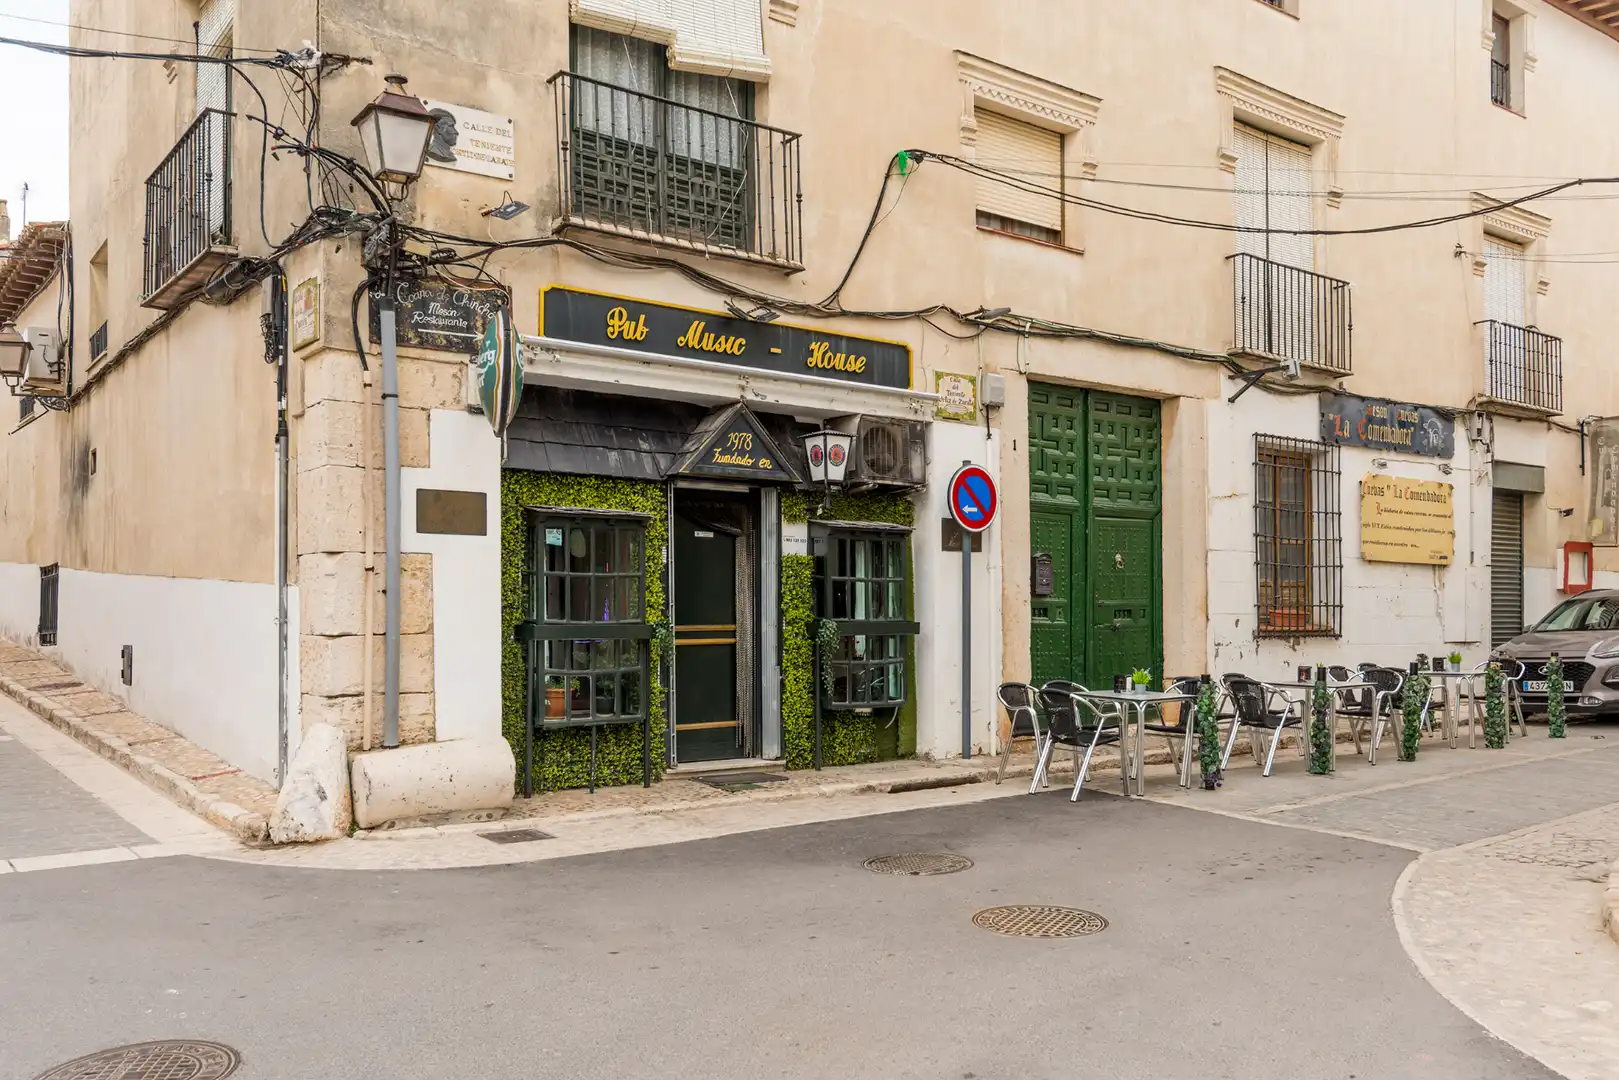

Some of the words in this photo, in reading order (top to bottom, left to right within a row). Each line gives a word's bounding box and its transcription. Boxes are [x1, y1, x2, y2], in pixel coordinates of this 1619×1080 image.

[462, 121, 493, 134] CALLE
[495, 127, 513, 139] DEL
[469, 138, 512, 155] TENIENTE
[411, 310, 468, 329] Restaurante
[606, 306, 649, 342] Pub
[676, 319, 747, 357] Music
[807, 340, 867, 374] House
[726, 432, 753, 451] 1978
[711, 447, 755, 467] Fundado
[758, 458, 773, 470] en
